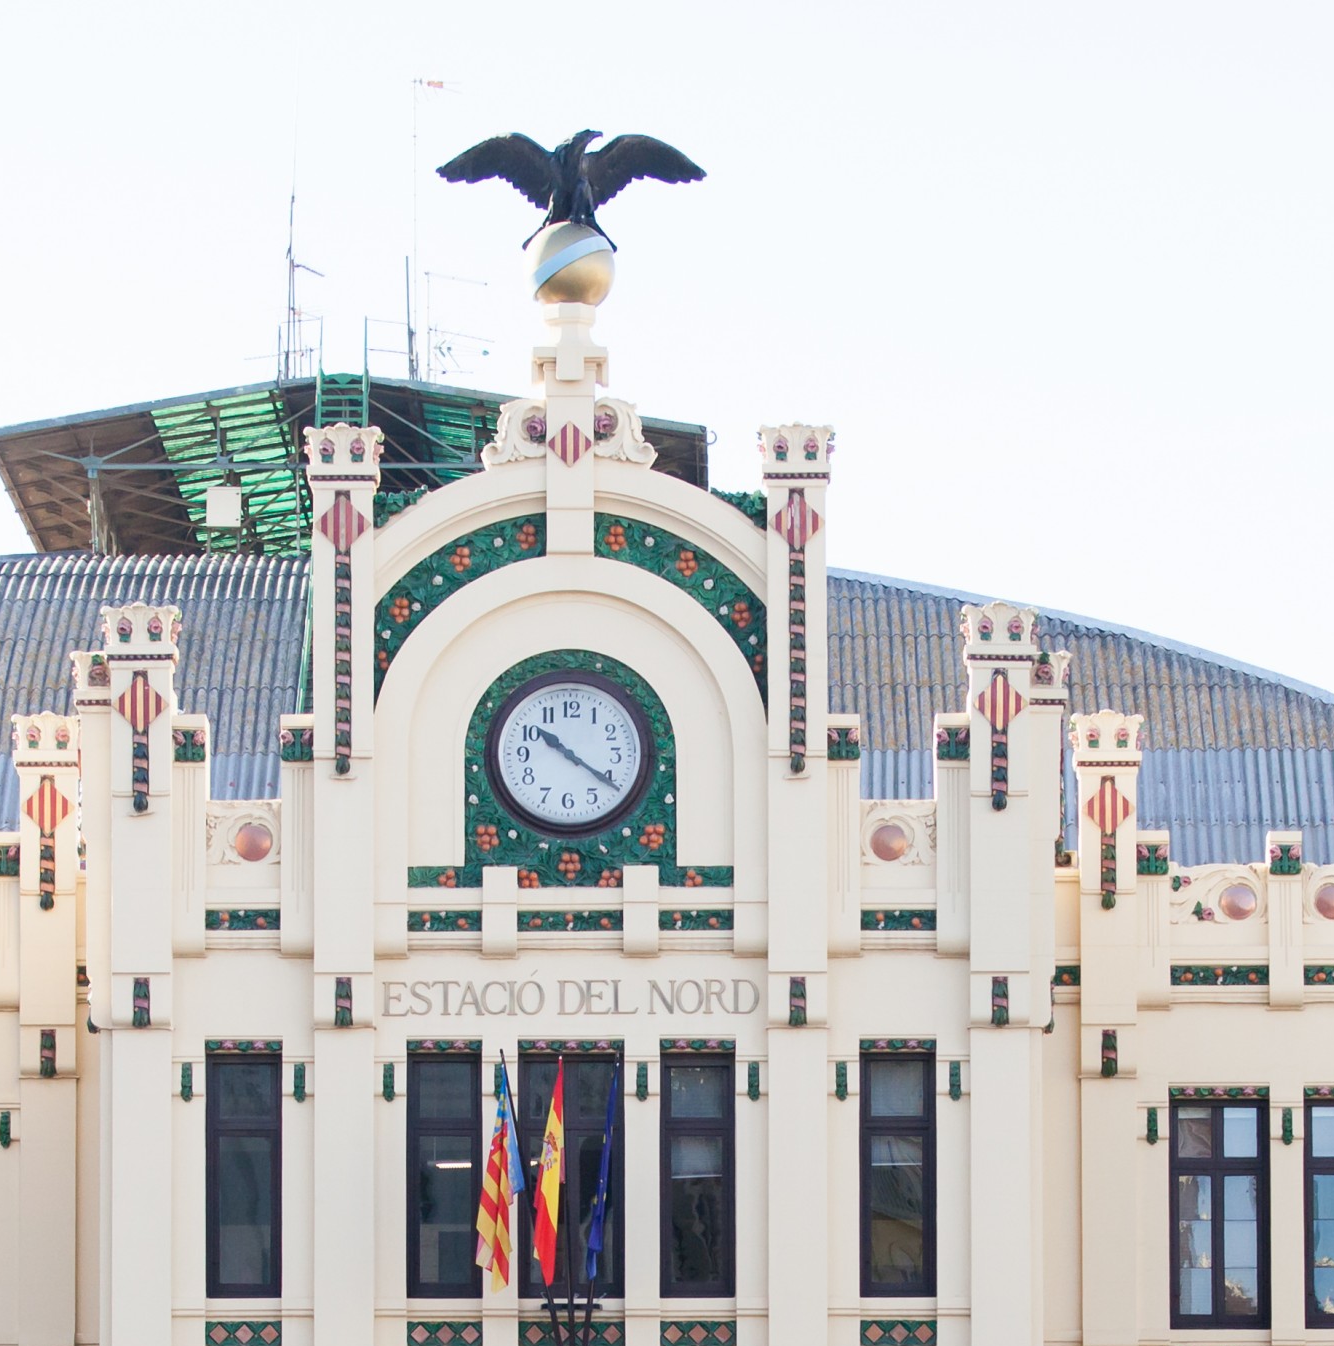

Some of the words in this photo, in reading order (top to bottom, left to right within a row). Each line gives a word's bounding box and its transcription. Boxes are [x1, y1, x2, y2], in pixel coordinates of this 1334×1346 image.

[542, 706, 555, 724] 11
[562, 701, 581, 718] 12
[591, 707, 597, 724] 1
[522, 725, 540, 742] 10
[605, 723, 617, 741] 2
[517, 746, 530, 763] 9
[610, 747, 622, 764] 3
[522, 767, 535, 785] 8
[539, 787, 552, 804] 7
[561, 792, 575, 809] 6
[586, 788, 598, 805] 5
[381, 969, 546, 1017] ESTACIÓ
[556, 978, 639, 1016] DEL
[647, 978, 761, 1015] NORD
